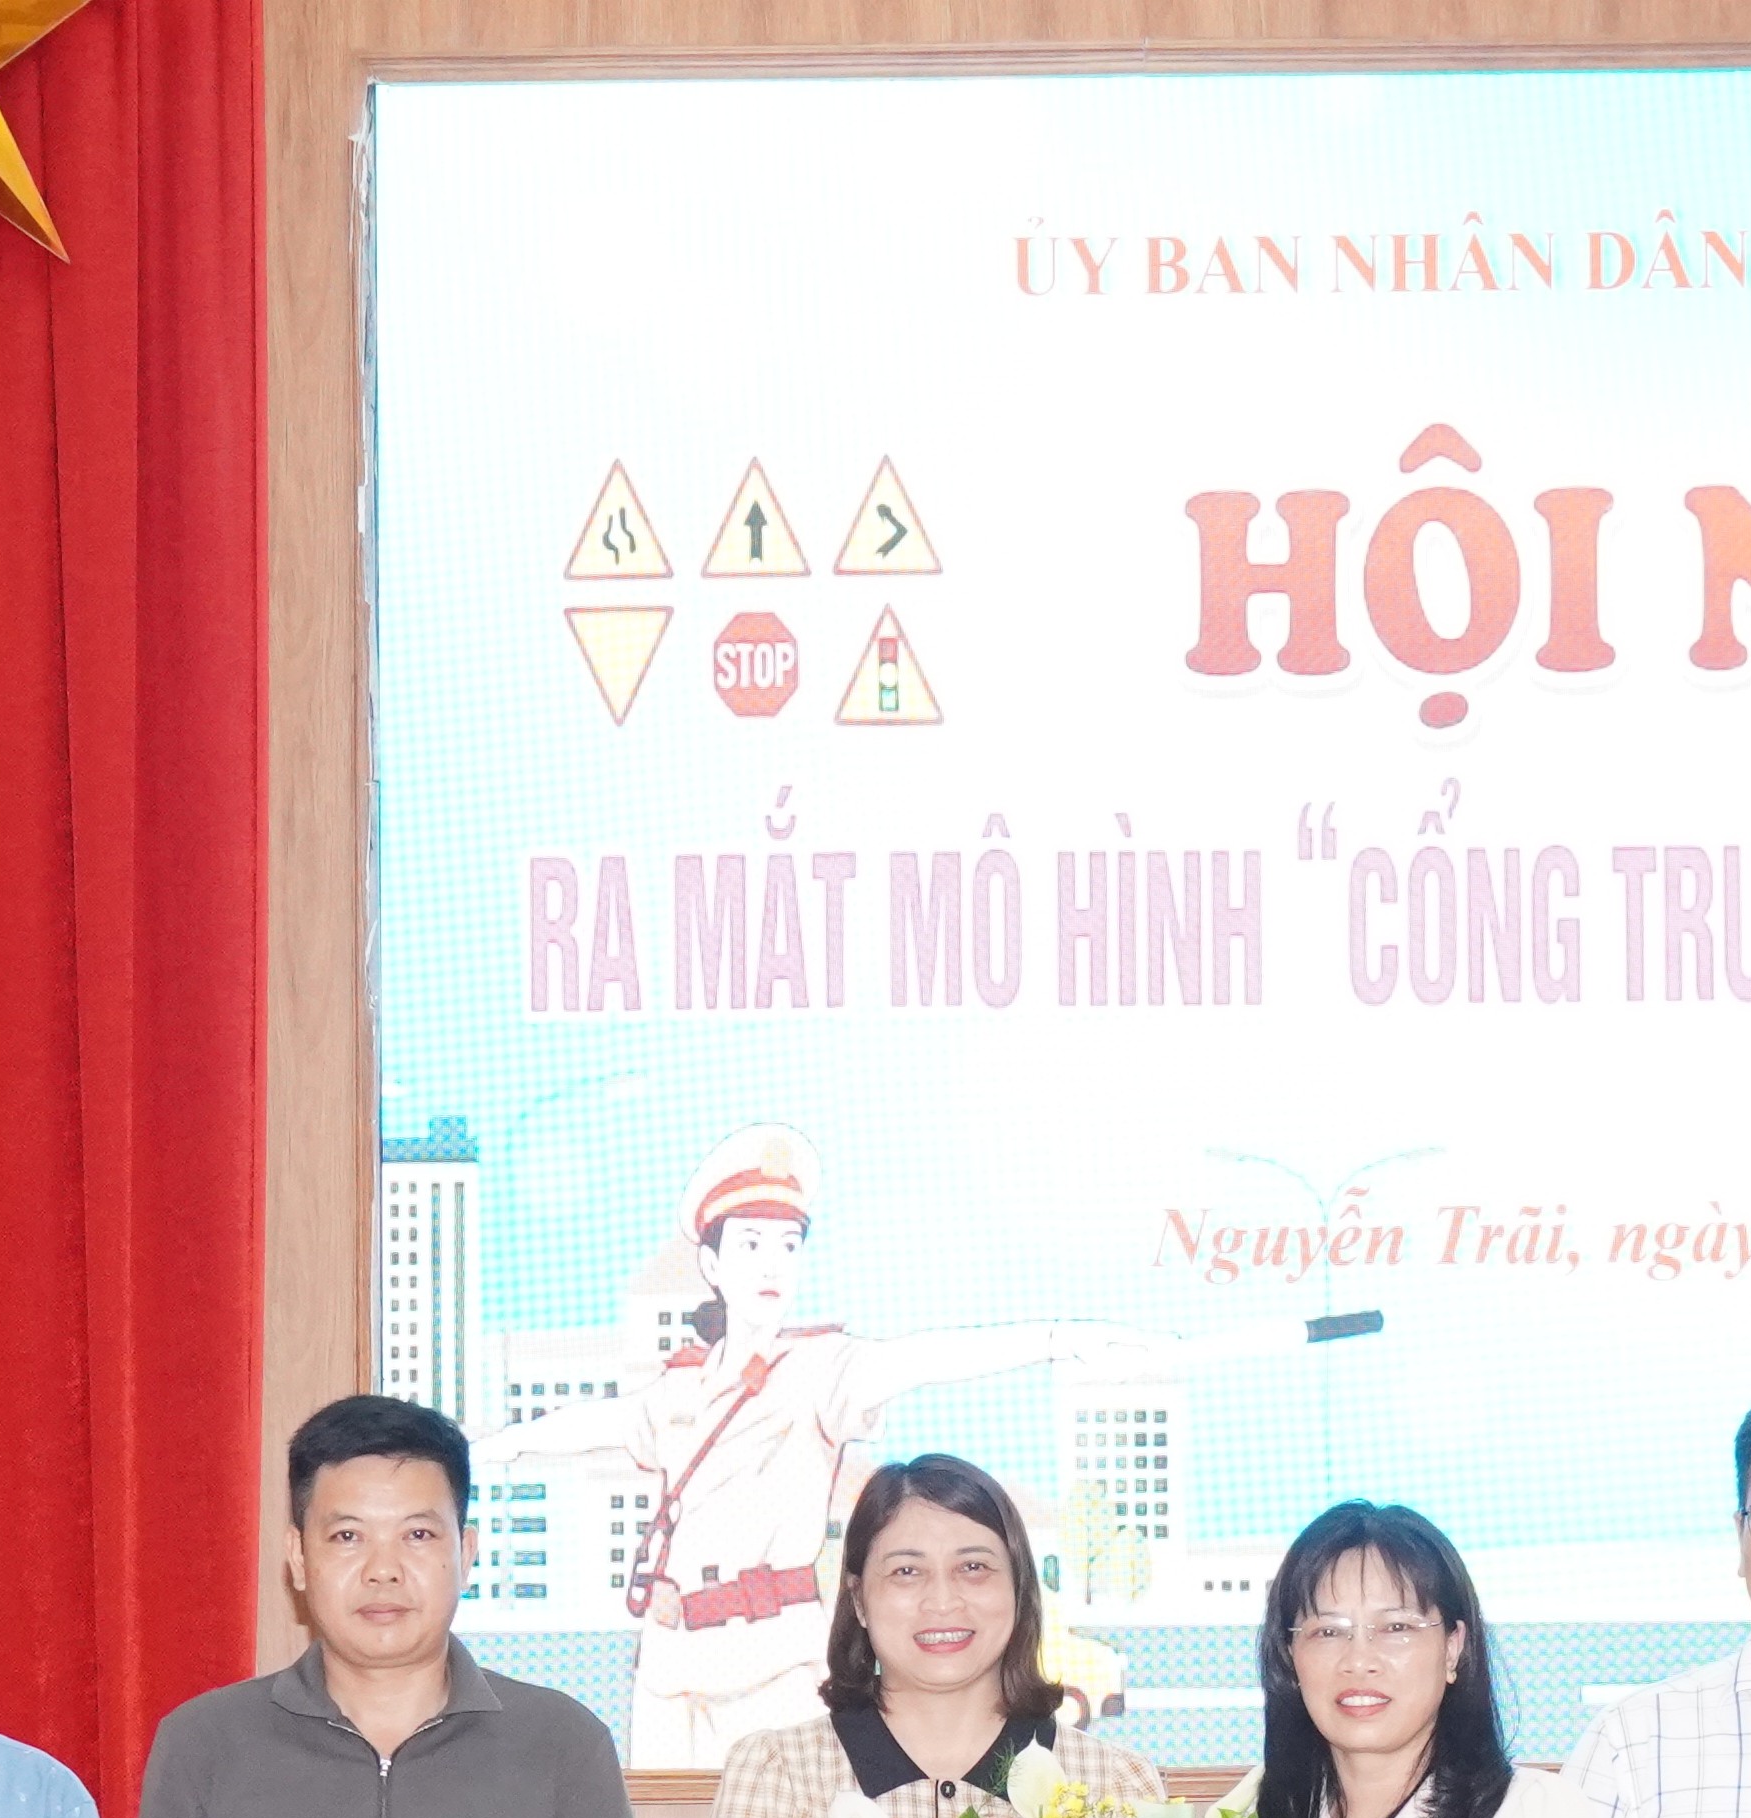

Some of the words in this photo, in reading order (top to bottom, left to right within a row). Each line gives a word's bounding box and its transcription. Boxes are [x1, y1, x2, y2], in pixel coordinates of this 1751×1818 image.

[1012, 215, 1120, 297] ỦY
[1145, 234, 1302, 296] BAN
[1328, 210, 1555, 294] NHÂN
[1584, 208, 1750, 291] DÂN
[1184, 422, 1617, 730] HỘI
[716, 641, 796, 690] STOP
[530, 856, 643, 1013] RA
[673, 783, 858, 1011] MẮT
[888, 812, 1022, 1009] MÔ
[1056, 811, 1263, 1007] HÌNH
[1297, 776, 1581, 1005] “CỔNG
[1151, 1186, 1406, 1286] Nguyễn
[1435, 1202, 1582, 1275] Trãi,
